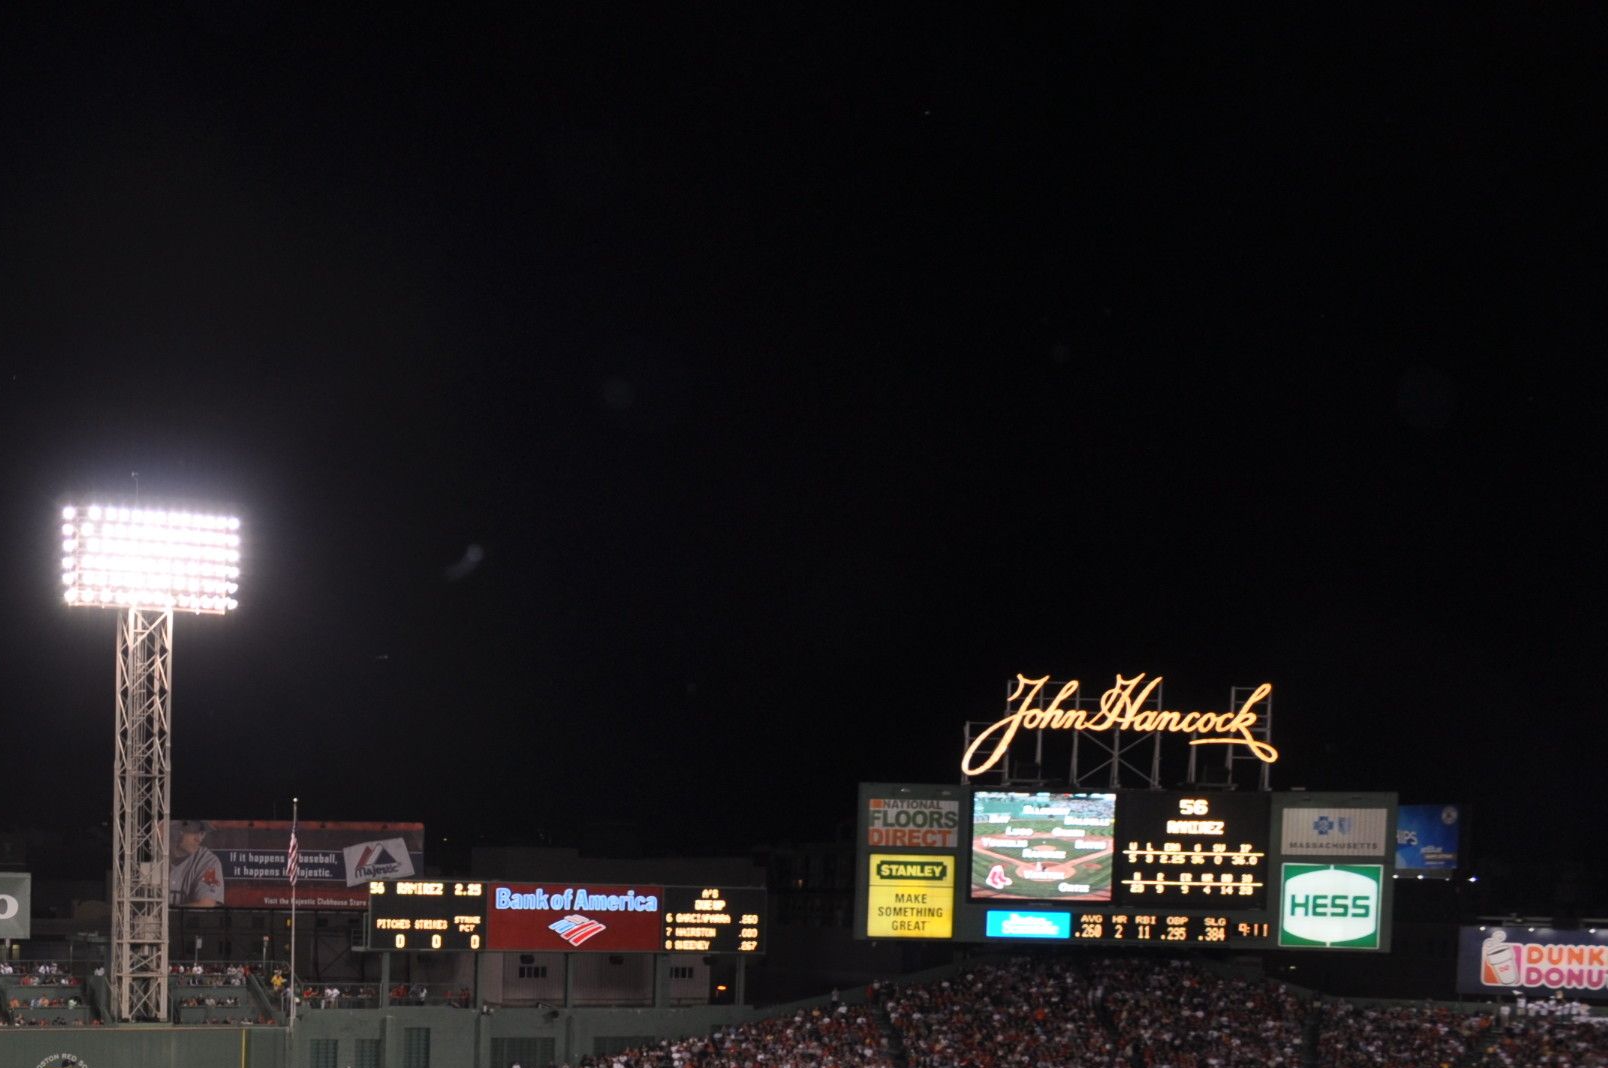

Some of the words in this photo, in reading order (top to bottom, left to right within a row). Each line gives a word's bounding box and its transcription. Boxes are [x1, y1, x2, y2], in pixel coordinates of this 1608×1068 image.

[961, 673, 1086, 775] John
[1086, 672, 1279, 763] Hancock
[883, 800, 943, 810] NATIONAL
[1179, 799, 1209, 815] 56
[869, 810, 959, 828] FLOORS
[868, 828, 952, 847] DIRECT
[1289, 841, 1379, 851] MASSACHUSETTS
[230, 852, 237, 863] If
[239, 852, 246, 863] it
[248, 852, 285, 866] happens
[234, 866, 241, 876] it
[243, 867, 280, 879] happens
[354, 861, 402, 879] Majestic
[880, 864, 943, 877] STANLEY
[495, 887, 550, 910] Bank
[550, 888, 573, 911] of
[573, 889, 658, 912] America
[895, 893, 927, 904] MAKE
[877, 906, 943, 918] SOMETHING
[1290, 894, 1370, 918] HESS
[891, 920, 927, 931] GREAT
[1080, 914, 1103, 924] AVG
[1112, 915, 1128, 924] HR
[1135, 915, 1157, 924] RBI
[1166, 916, 1189, 925] OBP
[1204, 917, 1226, 926] SLG
[1114, 924, 1123, 938] 2
[1137, 925, 1150, 939] 11
[1160, 926, 1187, 940] .295
[1198, 927, 1225, 941] .384
[61, 1053, 77, 1062] RED
